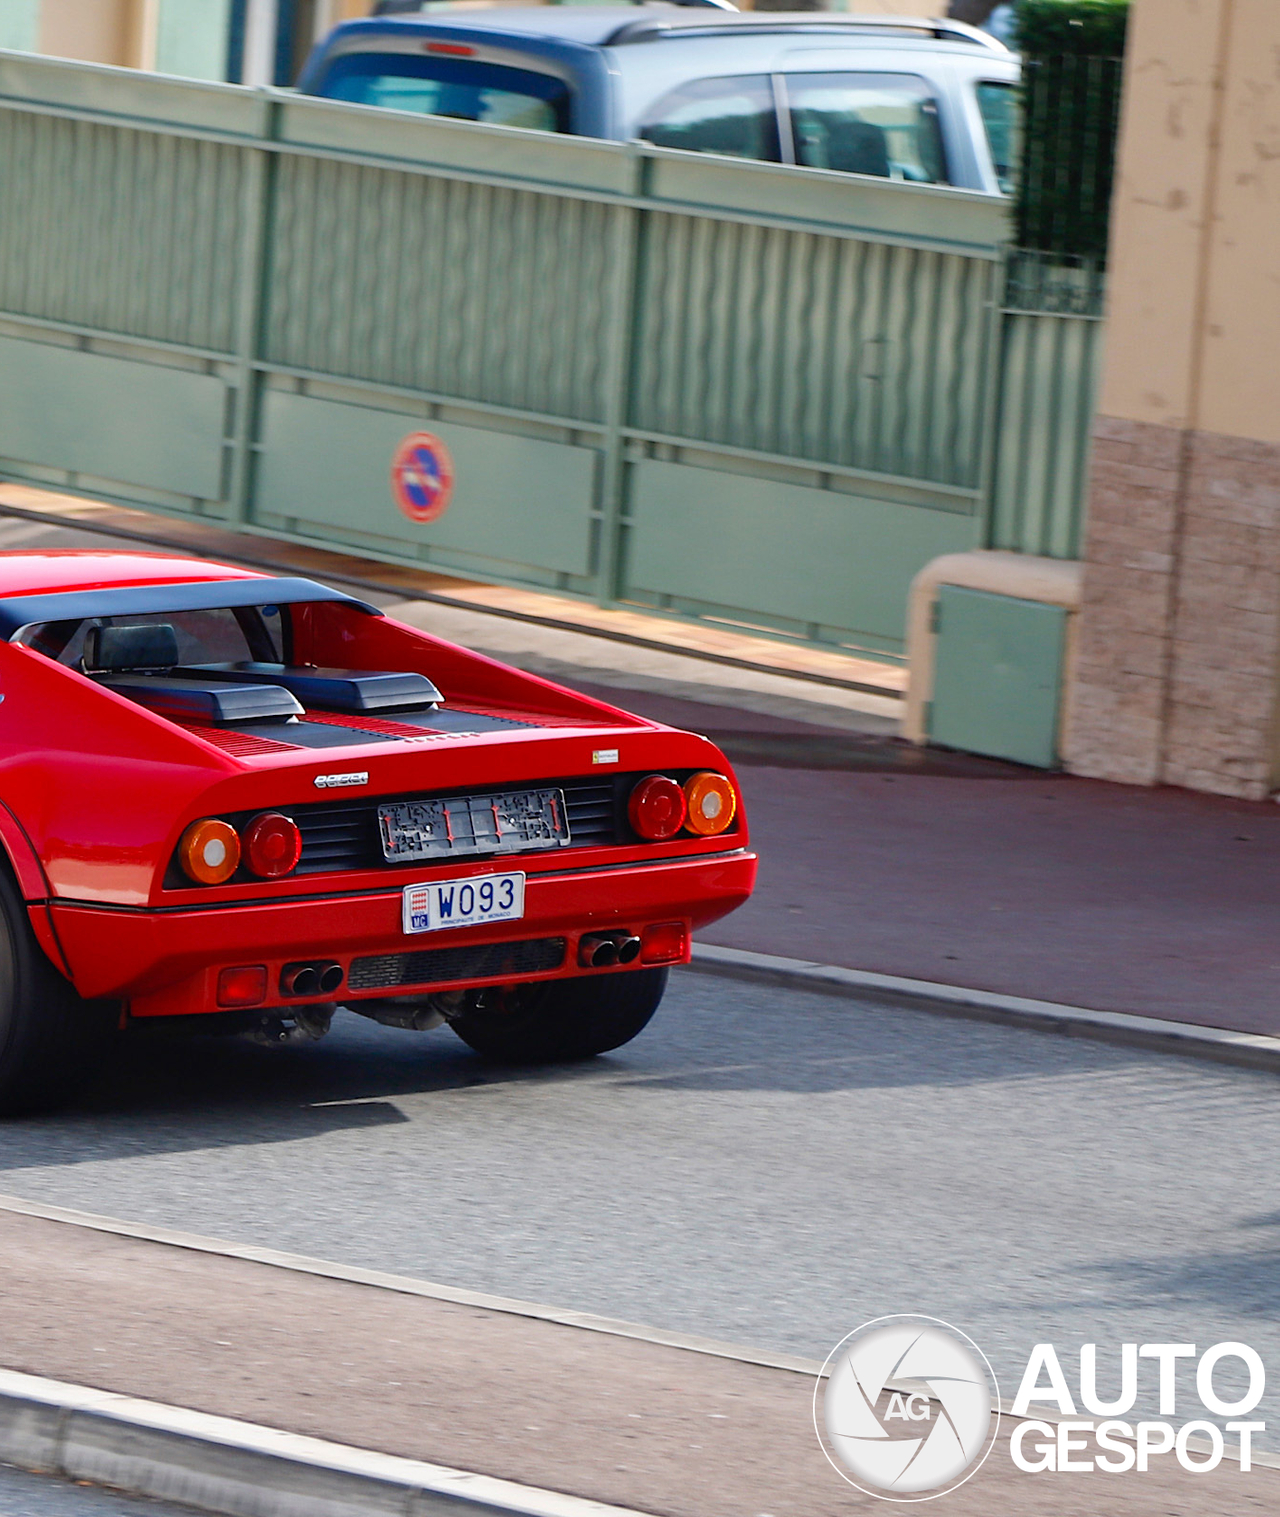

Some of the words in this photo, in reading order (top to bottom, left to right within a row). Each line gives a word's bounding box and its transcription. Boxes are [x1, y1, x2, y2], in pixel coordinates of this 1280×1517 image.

[438, 878, 514, 918] W093
[488, 911, 511, 919] MONACO
[413, 916, 426, 928] MC
